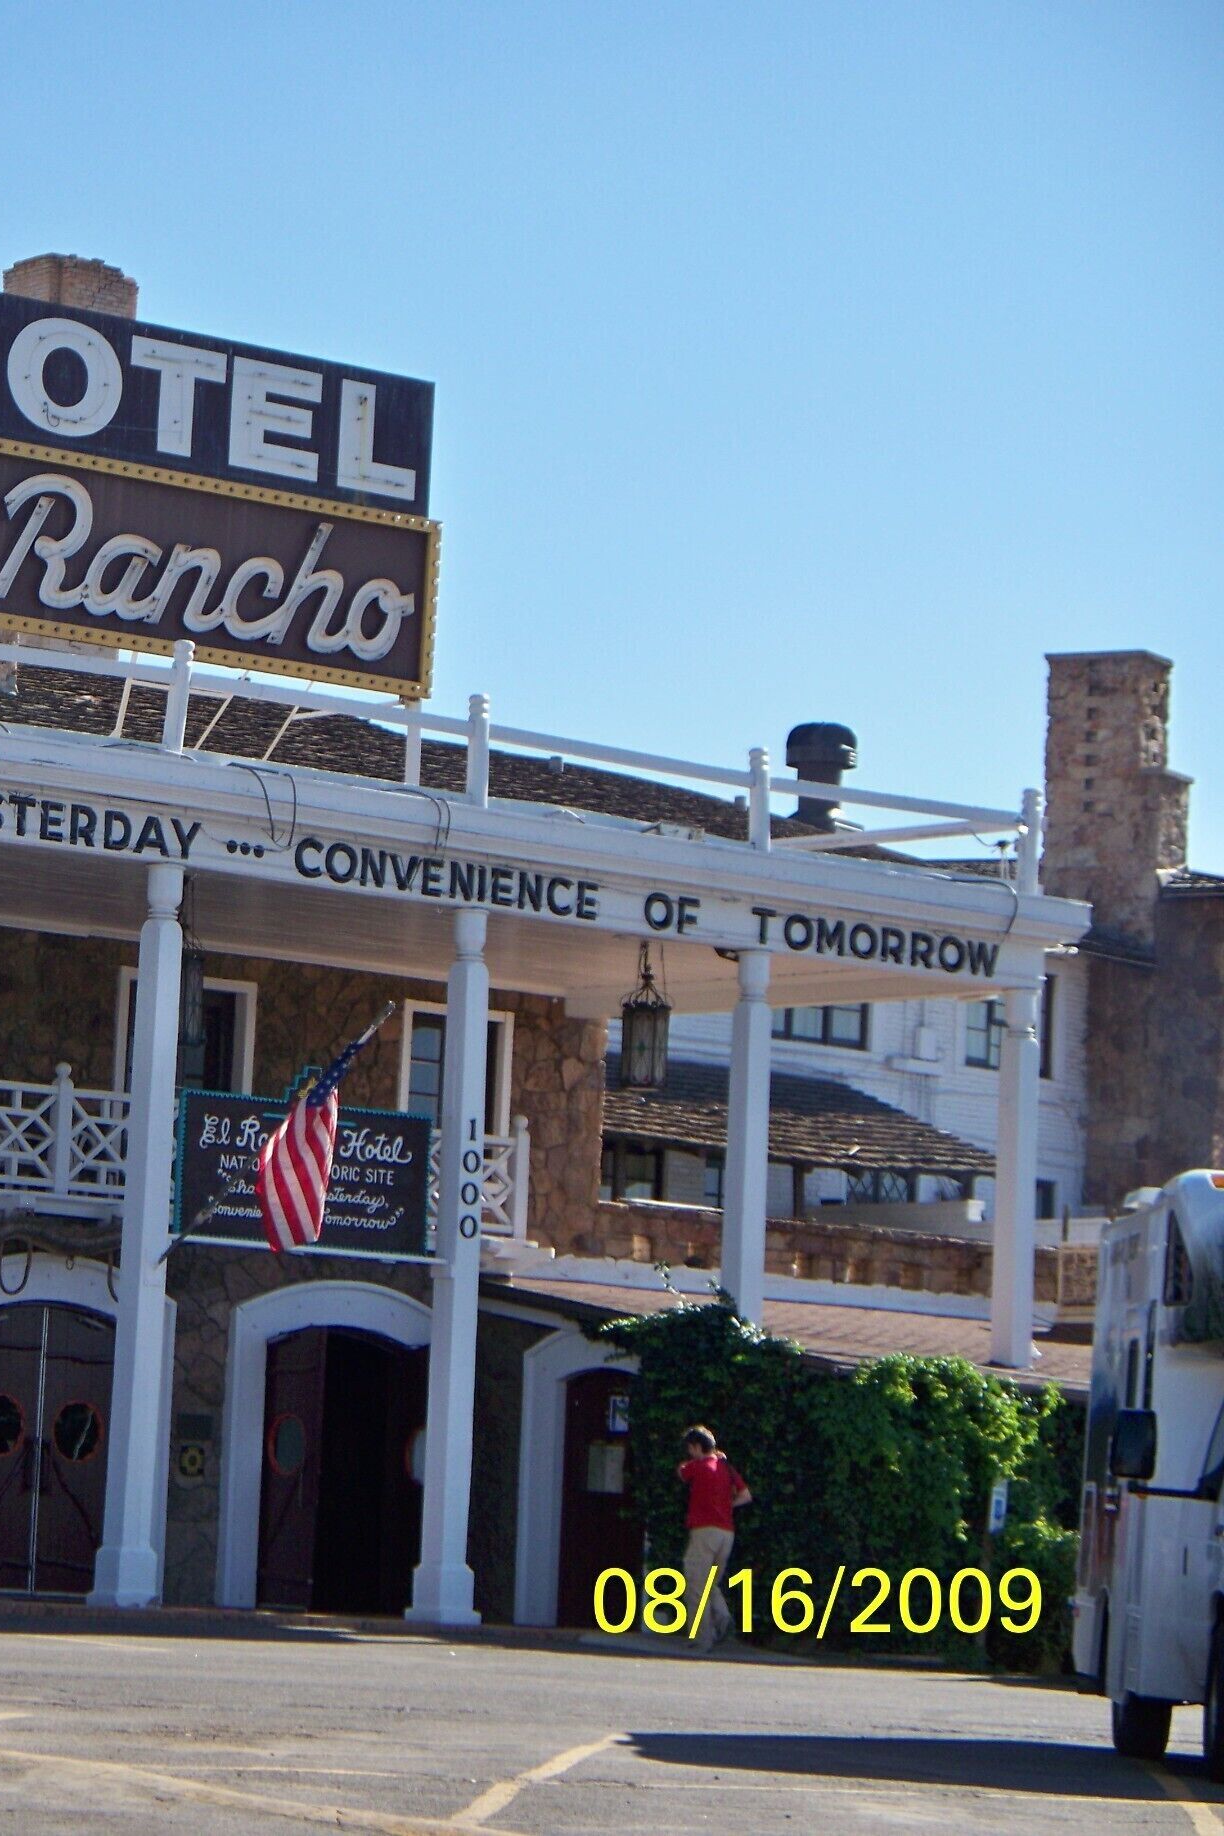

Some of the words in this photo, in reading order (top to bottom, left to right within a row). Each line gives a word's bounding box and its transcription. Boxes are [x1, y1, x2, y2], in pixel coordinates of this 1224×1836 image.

[294, 837, 601, 921] CONVENIENCE
[644, 892, 700, 934] OF
[752, 906, 1000, 977] TOMORROW
[199, 1112, 231, 1149] El
[339, 1128, 413, 1164] Hotel
[365, 1168, 395, 1187] SITE
